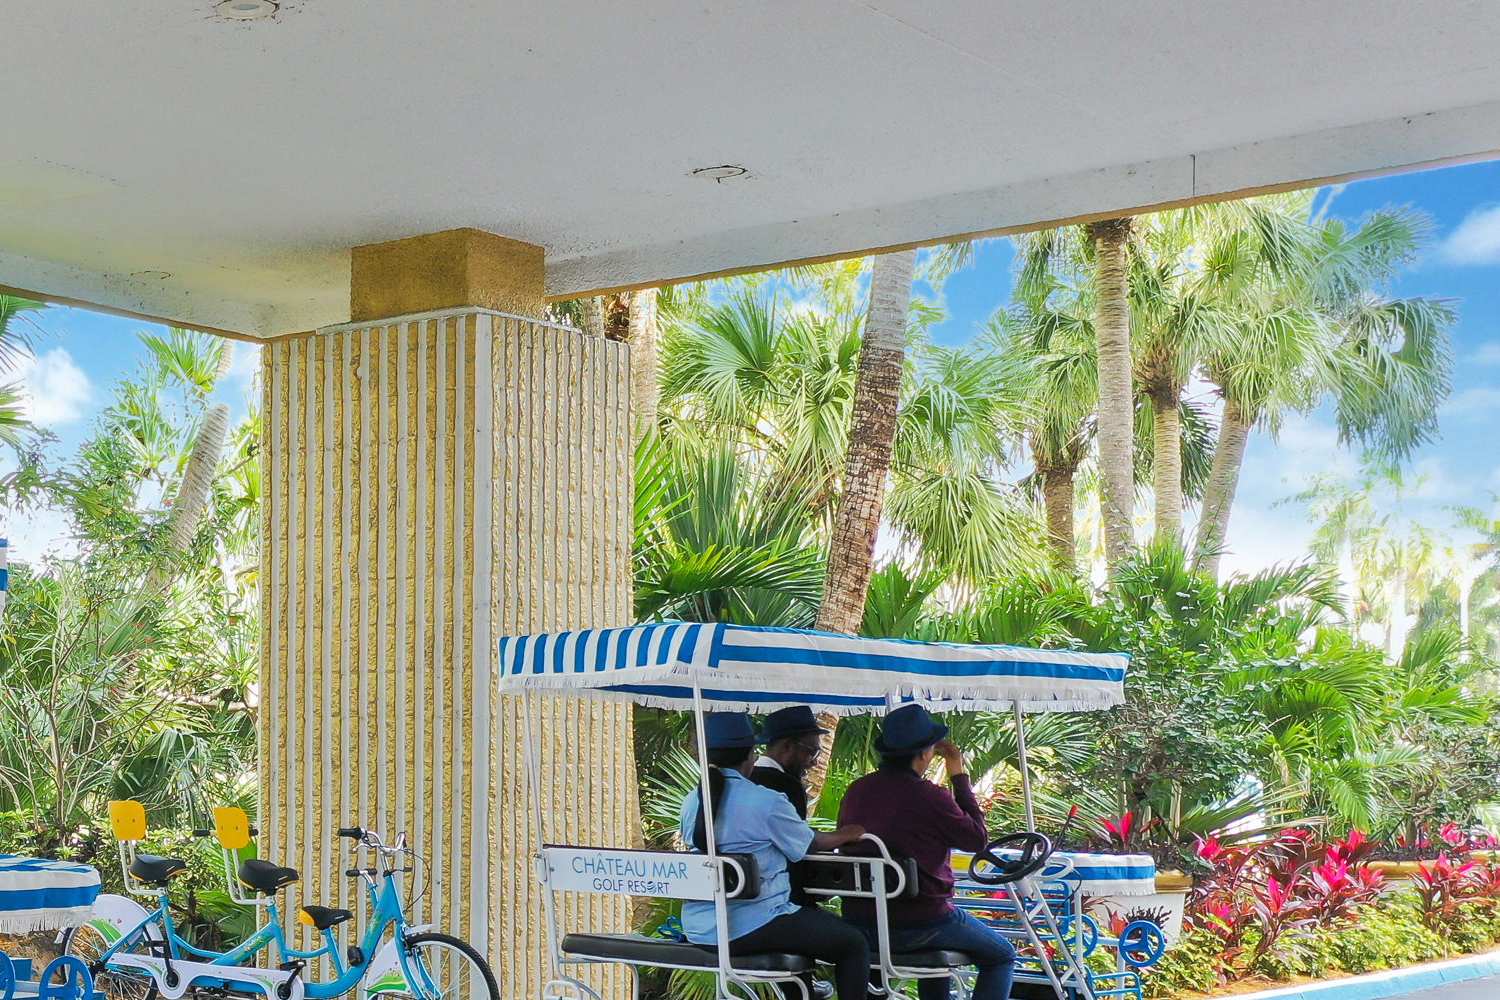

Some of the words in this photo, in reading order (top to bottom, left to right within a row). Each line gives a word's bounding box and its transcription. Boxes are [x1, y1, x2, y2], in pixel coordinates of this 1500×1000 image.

[572, 853, 646, 876] CHÂTEAU
[652, 861, 688, 879] MAR
[593, 878, 624, 892] GOLF
[628, 880, 670, 895] RESORT
